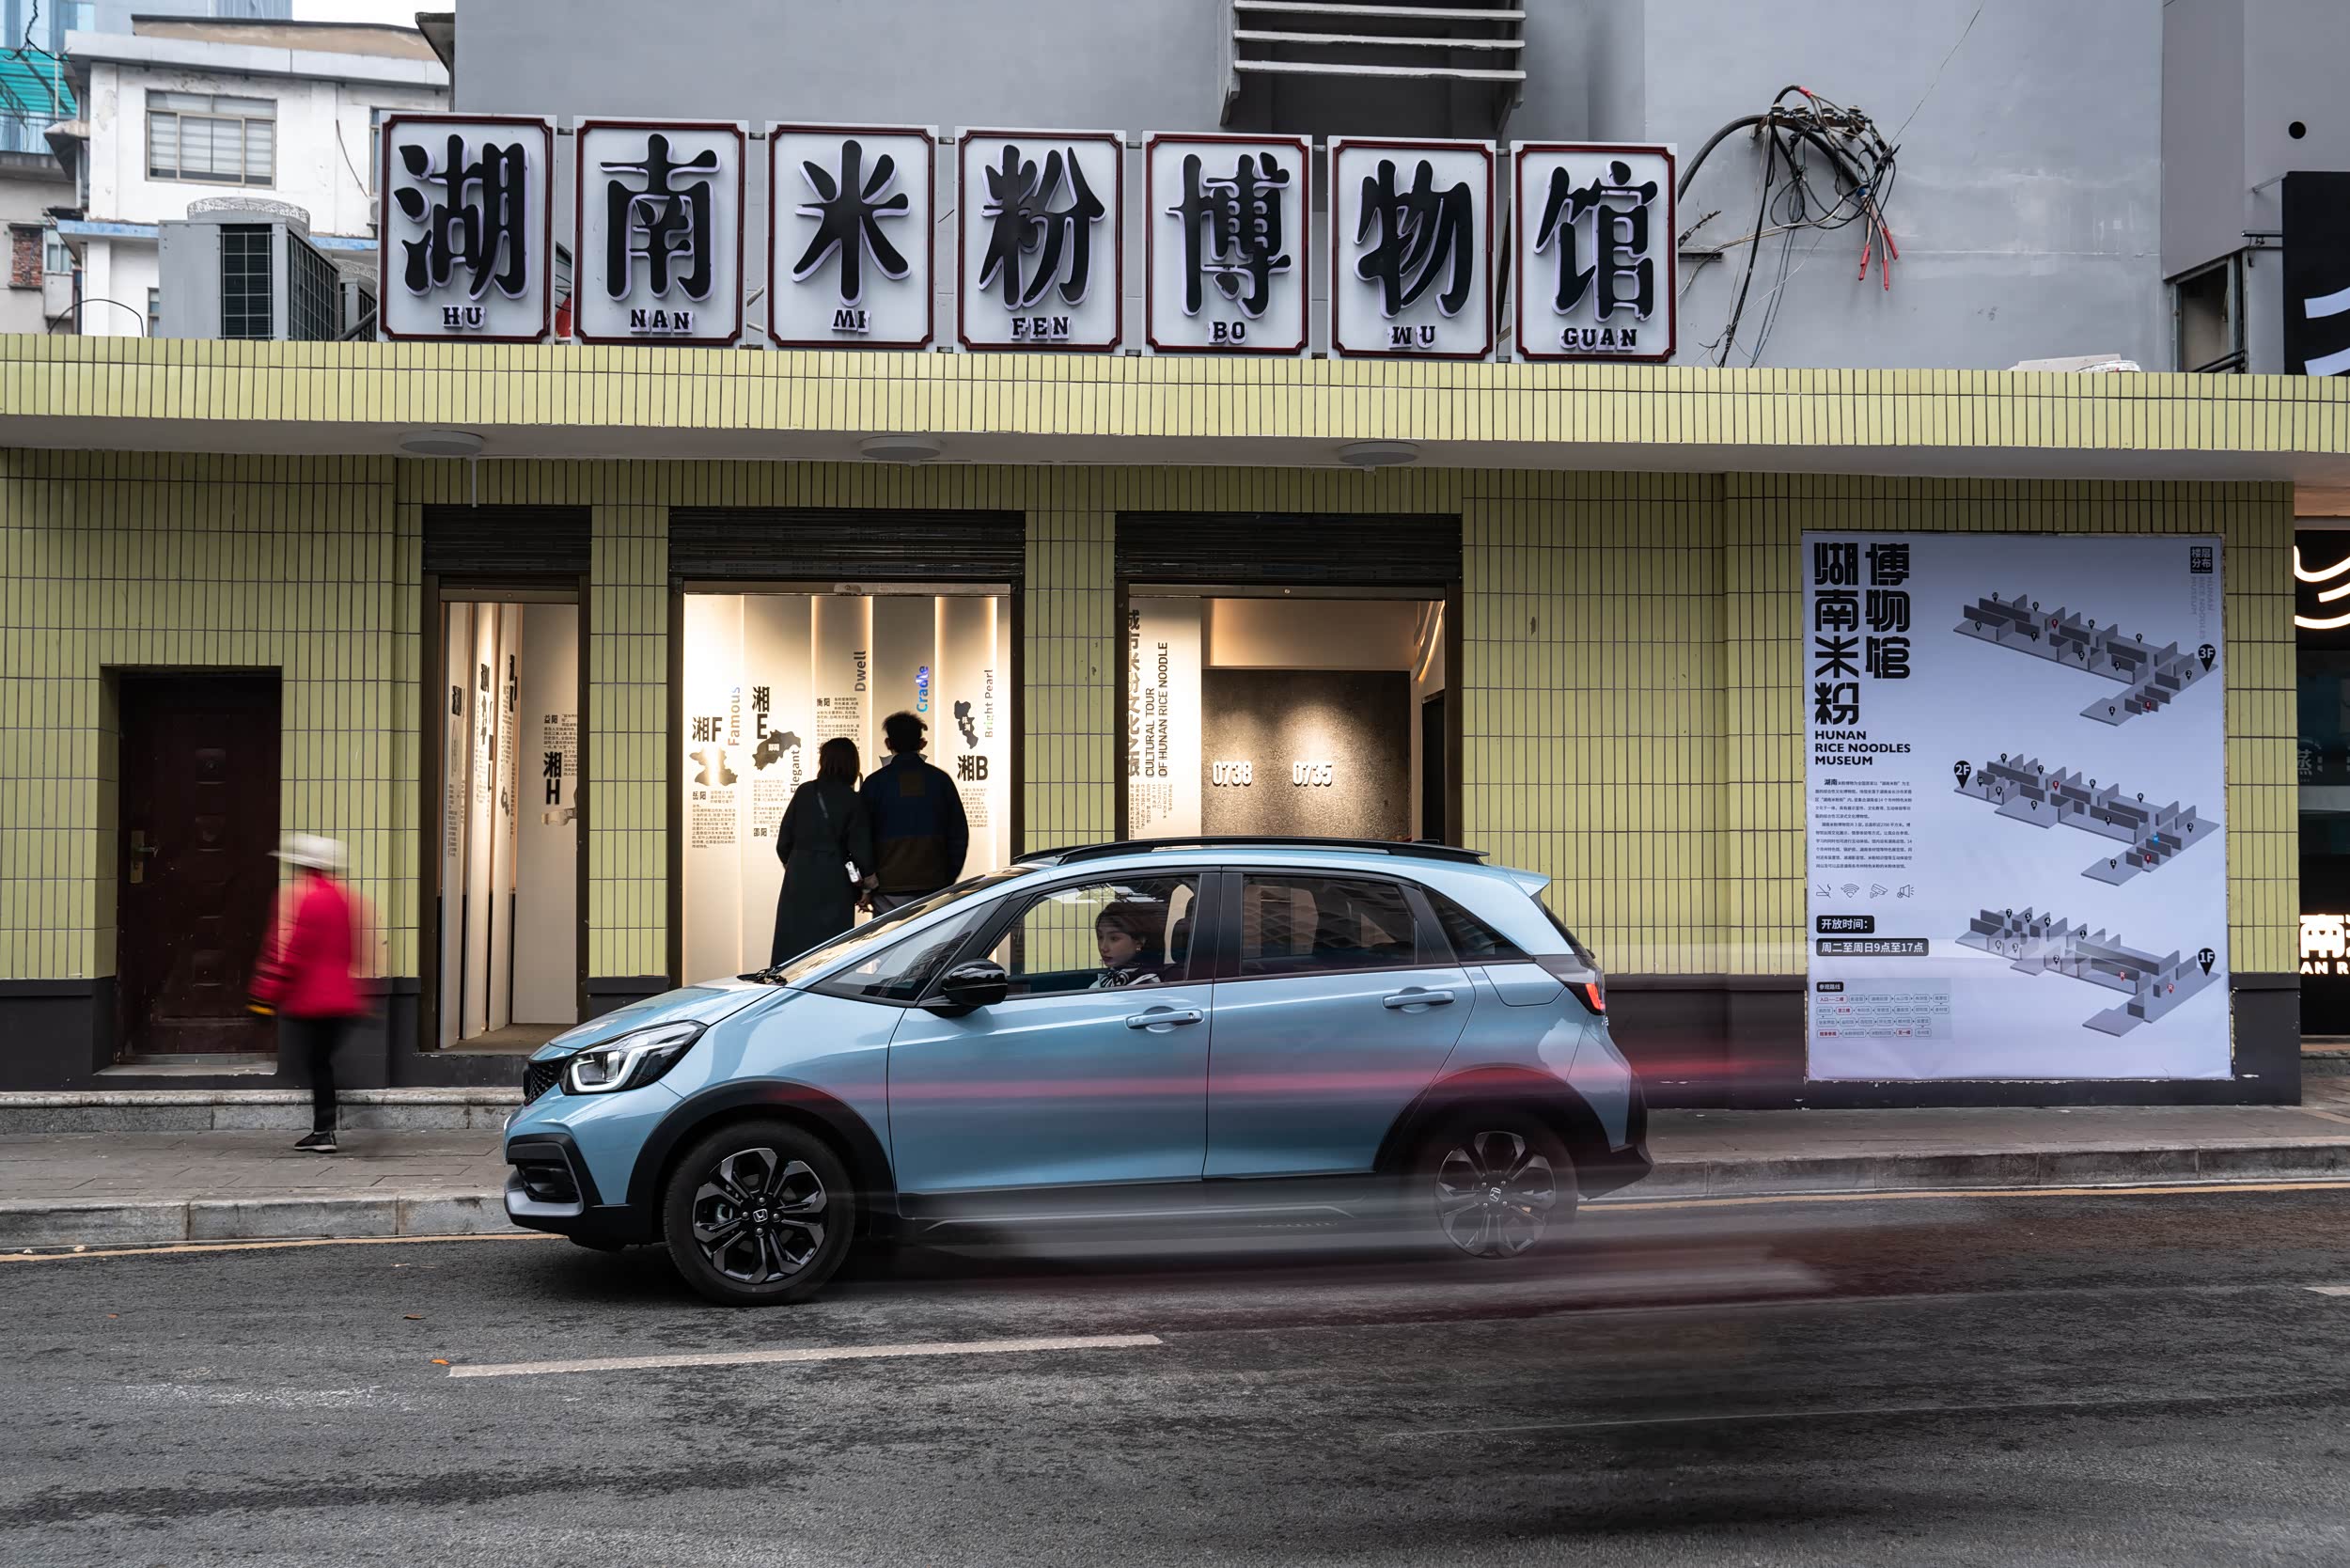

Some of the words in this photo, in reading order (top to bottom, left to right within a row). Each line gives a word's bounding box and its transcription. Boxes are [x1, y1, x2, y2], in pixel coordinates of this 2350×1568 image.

[393, 133, 1659, 322] 湖南米粉博物馆
[443, 306, 486, 329] HU
[630, 308, 694, 334] NAN
[832, 308, 870, 334] MI
[1010, 315, 1070, 339] FEN
[1208, 321, 1246, 344] BO
[1388, 325, 1435, 349] WU
[1560, 326, 1639, 352] GUAN
[2191, 558, 2212, 569] 分布
[1865, 542, 1910, 680] 博物馆
[1814, 542, 1859, 726] 湖南米粉
[1157, 642, 1167, 688] NOODLE
[2199, 648, 2214, 659] 3F
[854, 651, 867, 692] Dwell
[983, 669, 994, 700] Pearl
[916, 666, 929, 713] Cradle
[1145, 687, 1154, 718] TOUR
[1157, 690, 1167, 716] RICE
[728, 686, 741, 745] Famous
[752, 686, 770, 739] 湘E
[983, 702, 995, 738] Bright
[692, 716, 723, 743] 湘F
[1157, 719, 1167, 760] HUNAN
[1814, 730, 1867, 741] HUNAN
[1145, 720, 1154, 777] CULTURAL
[1814, 744, 1844, 754] RICE
[1847, 743, 1911, 754] NOODLES
[1814, 756, 1873, 766] MUSEUM
[543, 751, 562, 805] 湘H
[957, 755, 988, 781] 湘B
[1157, 760, 1167, 777] OF
[1213, 760, 1253, 787] 0738
[1292, 760, 1333, 787] 0735
[1955, 764, 1970, 776] 2F
[1821, 918, 1869, 930] 开放时间：
[1821, 942, 1924, 953] 周二至周日9点至17点
[2200, 951, 2214, 963] 1F
